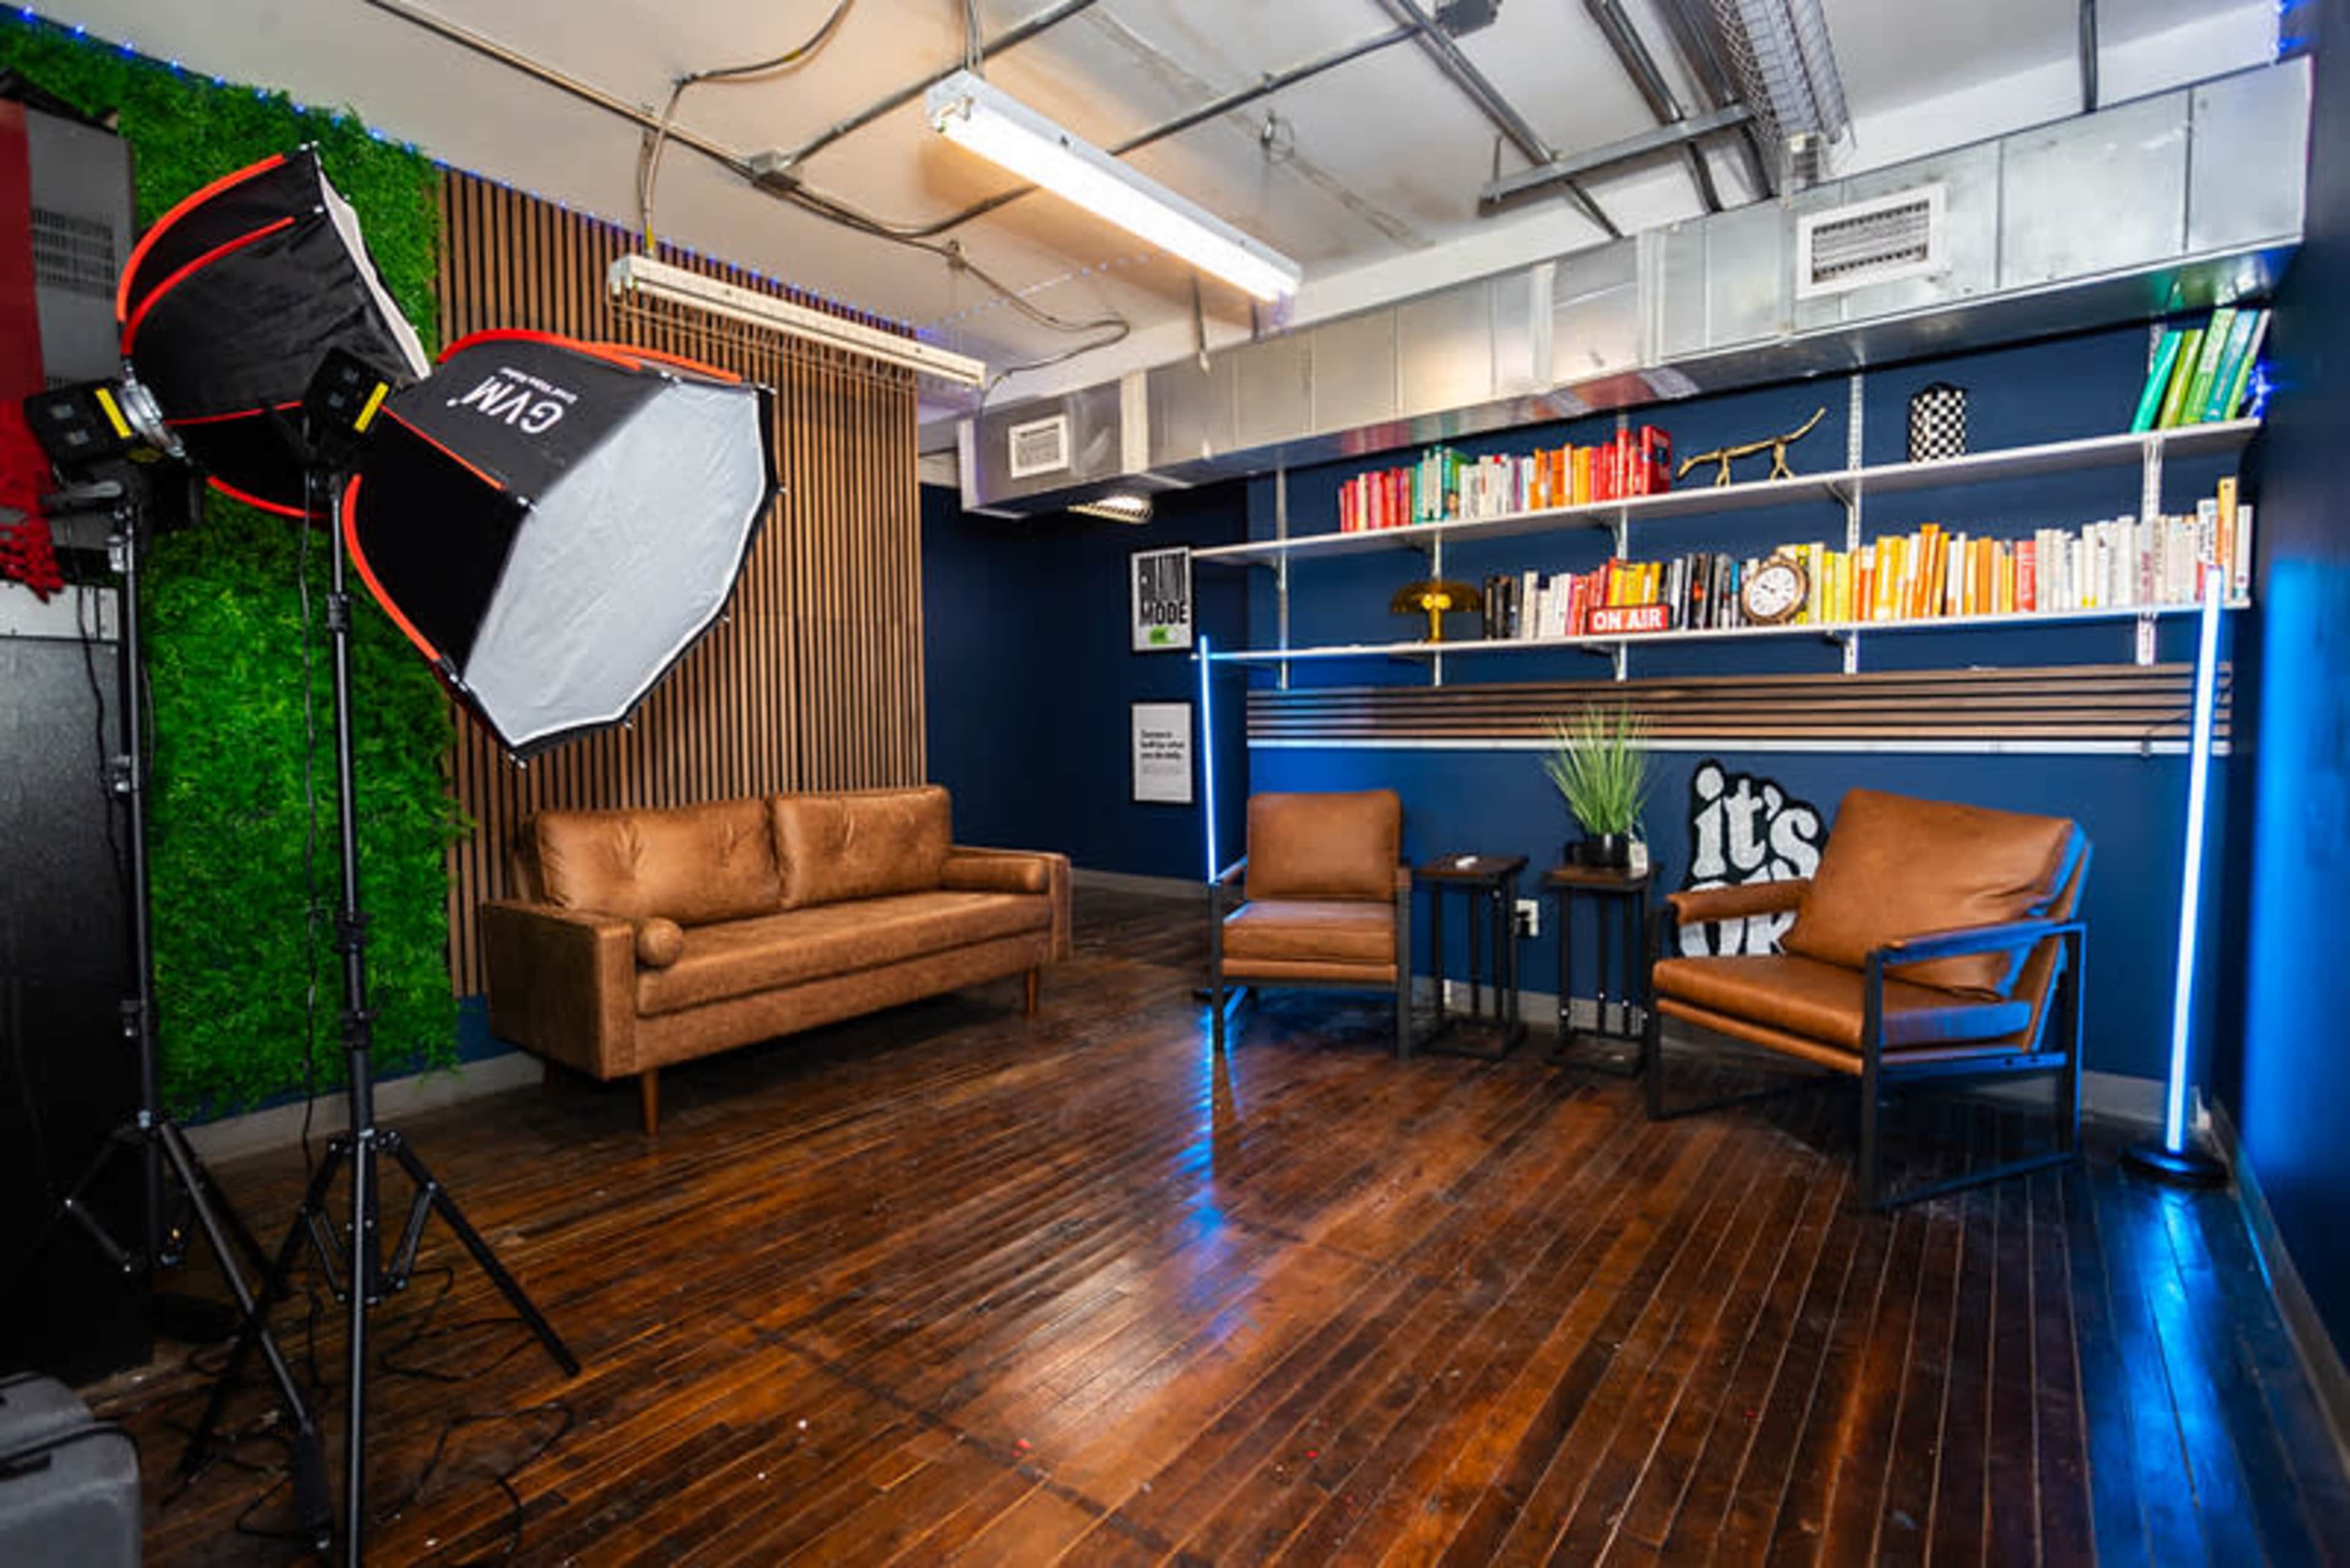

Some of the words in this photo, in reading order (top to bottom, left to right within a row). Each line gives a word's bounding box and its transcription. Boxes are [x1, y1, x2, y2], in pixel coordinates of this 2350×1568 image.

[459, 375, 564, 434] GVM
[1592, 610, 1622, 631] ON
[1625, 607, 1663, 630] AIR
[1691, 766, 1821, 881] it's
